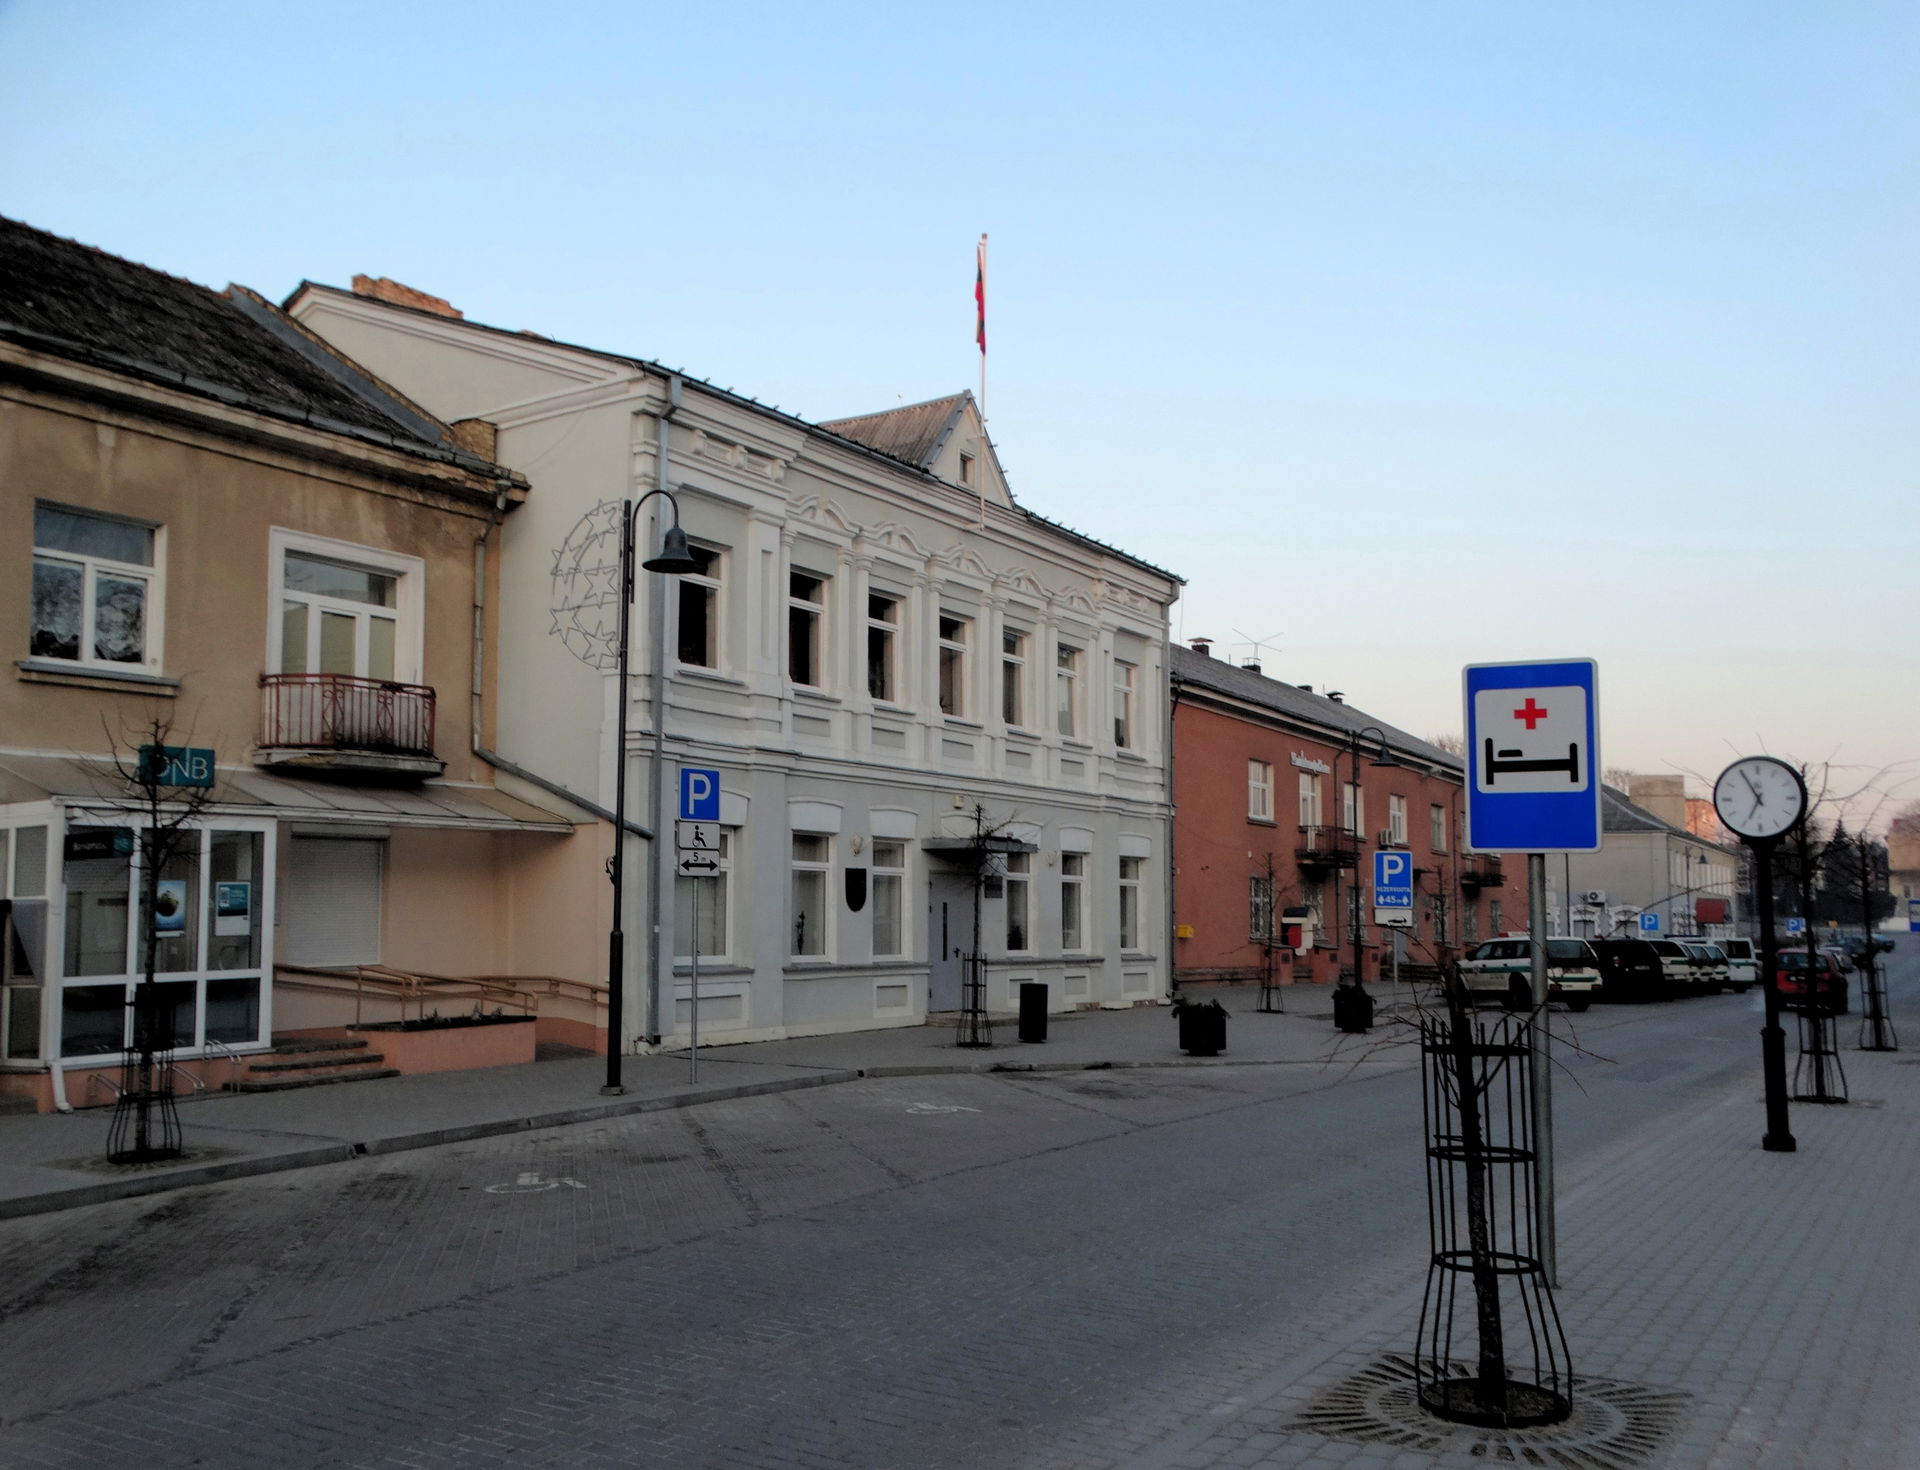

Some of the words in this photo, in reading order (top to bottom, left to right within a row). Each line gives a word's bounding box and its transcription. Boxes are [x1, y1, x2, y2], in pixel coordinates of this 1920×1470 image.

[688, 773, 711, 815] P
[693, 852, 699, 862] 5
[1383, 855, 1404, 884] P
[1385, 895, 1396, 903] 45
[1644, 915, 1655, 929] P
[1788, 919, 1798, 930] P
